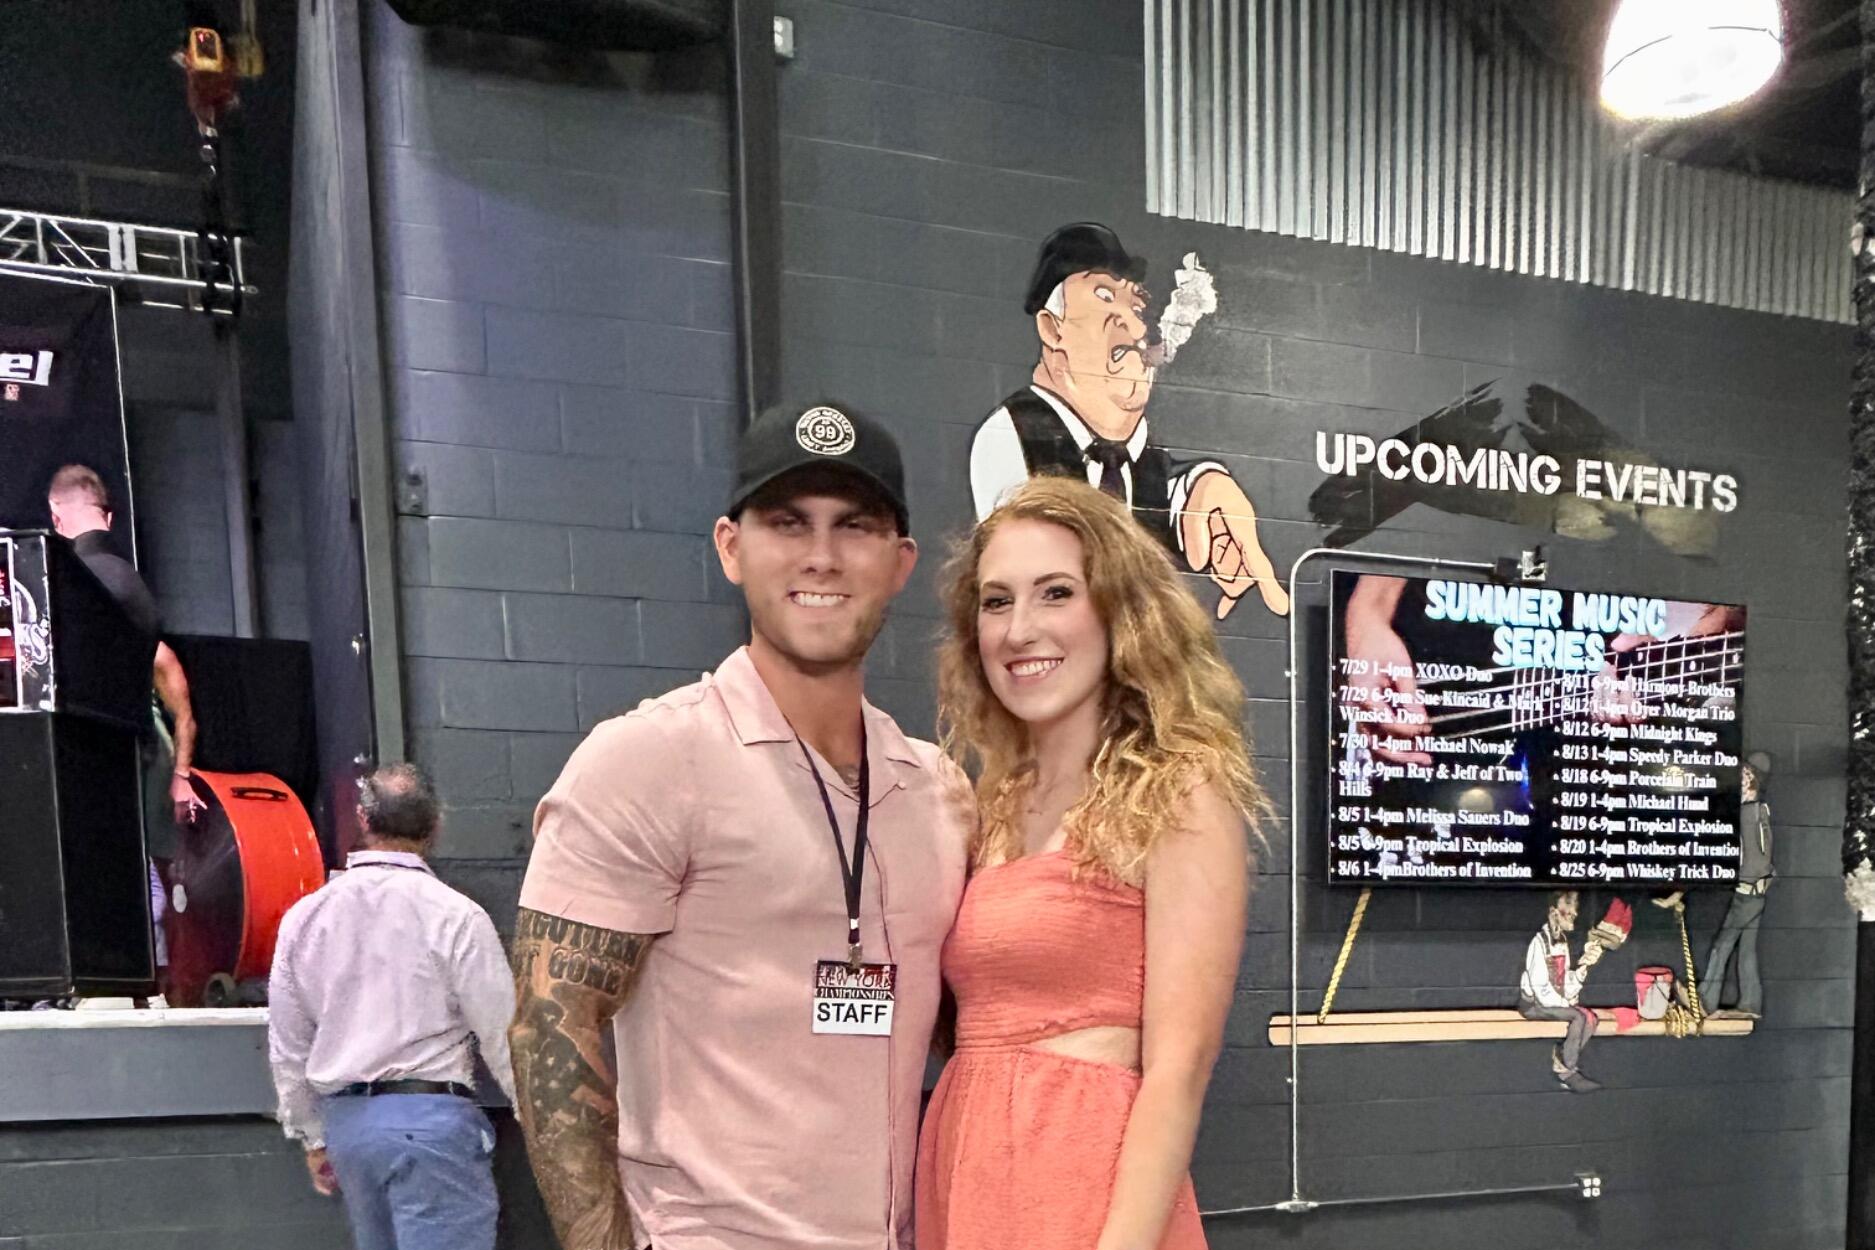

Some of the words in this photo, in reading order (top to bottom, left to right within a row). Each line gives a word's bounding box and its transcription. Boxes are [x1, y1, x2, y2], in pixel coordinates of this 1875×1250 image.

[1316, 431, 1561, 496] UPCOMING
[1576, 458, 1738, 512] EVENTS
[1424, 579, 1563, 629] SUMMER
[1572, 592, 1667, 636] MUSIC
[1492, 626, 1606, 672] SERIES
[1339, 658, 1368, 676] 7/29
[1372, 661, 1413, 681] 1-4pm
[1416, 662, 1463, 681] XOXO
[1465, 666, 1493, 682] Duo
[1339, 685, 1366, 703] 7/29
[1370, 687, 1413, 708] 6-9pm
[1415, 689, 1440, 706] Sue
[1442, 690, 1492, 708] Kincaid
[1493, 693, 1505, 709] &
[1688, 681, 1736, 698] Brothers
[1400, 708, 1426, 725] Duo
[1663, 703, 1708, 722] Morgan
[1709, 706, 1736, 721] Trio
[1562, 720, 1590, 737] 8/12
[1590, 722, 1629, 742] 6-9pm
[1629, 724, 1683, 744] Midnight
[1685, 727, 1718, 746] Kings
[1371, 734, 1412, 755] 1-4pm
[1415, 735, 1468, 754] Michael
[1561, 744, 1589, 760] 8/13
[1591, 746, 1628, 765] 1-4pm
[1629, 747, 1670, 766] Speedy
[1673, 750, 1713, 767] Parker
[1714, 751, 1739, 767] Duo
[1362, 760, 1405, 781] 6-9pm
[1406, 762, 1435, 783] Ray
[1436, 762, 1451, 780] &
[1451, 764, 1478, 781] Jeff
[1480, 765, 1494, 781] of
[1561, 768, 1588, 784] 8/18
[1589, 769, 1628, 788] 6-9pm
[1686, 773, 1717, 789] Train
[1339, 780, 1373, 797] Hills
[1560, 792, 1588, 807] 8/19
[1590, 793, 1628, 812] 1-4pm
[1628, 794, 1676, 811] Michael
[1338, 806, 1360, 822] 8/5
[1363, 807, 1405, 826] 1-4pm
[1406, 807, 1456, 825] Melissa
[1503, 811, 1530, 826] Duo
[1560, 815, 1587, 831] 8/19
[1588, 816, 1627, 835] 6-9pm
[1627, 817, 1677, 836] Tropical
[1678, 818, 1734, 837] Explosion
[1338, 835, 1360, 851] 8/5
[1360, 835, 1404, 855] 6-9pm
[1405, 835, 1461, 855] Tropical
[1462, 837, 1525, 857] Explosion
[1559, 838, 1586, 855] 8/20
[1588, 839, 1626, 858] 1-4pm
[1627, 840, 1677, 856] Brothers
[1678, 841, 1692, 856] of
[1338, 860, 1360, 876] 8/6
[1458, 862, 1474, 878] of
[1475, 862, 1533, 878] Invention
[1558, 862, 1587, 878] 8/25
[1587, 863, 1625, 882] 6-9pm
[1626, 863, 1677, 881] Whiskey
[1678, 864, 1710, 879] Trick
[1712, 864, 1737, 880] Duo
[816, 1002, 888, 1024] STAFF
